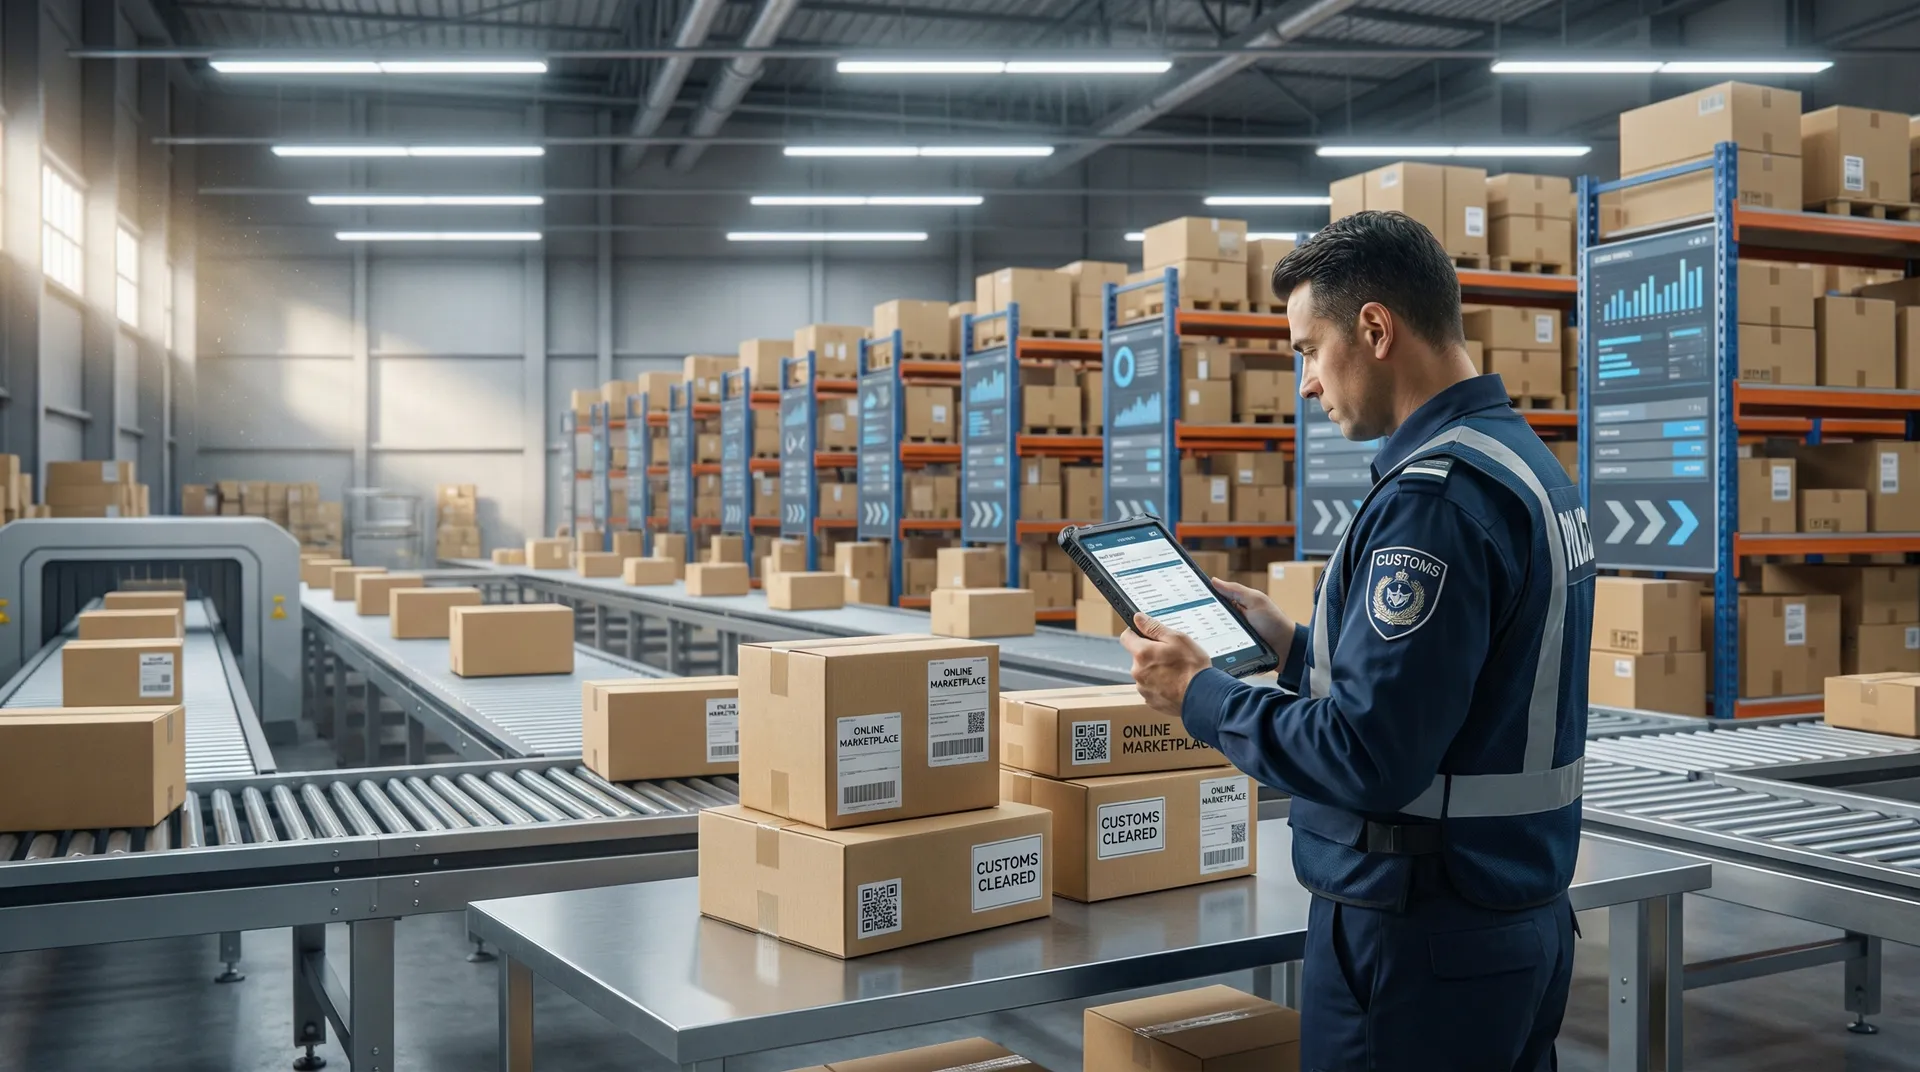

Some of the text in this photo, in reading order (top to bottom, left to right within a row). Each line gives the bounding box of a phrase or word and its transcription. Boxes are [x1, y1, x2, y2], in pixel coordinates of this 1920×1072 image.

[1376, 553, 1441, 578] CUSTOMS
[943, 667, 973, 677] ONLINE
[930, 676, 986, 689] MARKETPLACE
[853, 724, 885, 736] ONLINE
[1123, 723, 1170, 738] ONLINE
[839, 734, 899, 748] MARKETPLACE
[1122, 738, 1215, 754] MARKETPLAC
[1101, 810, 1160, 830] CUSTOMS
[1102, 826, 1158, 846] CLEARED
[976, 852, 1039, 876] CUSTOMS
[978, 869, 1037, 893] CLEARED
